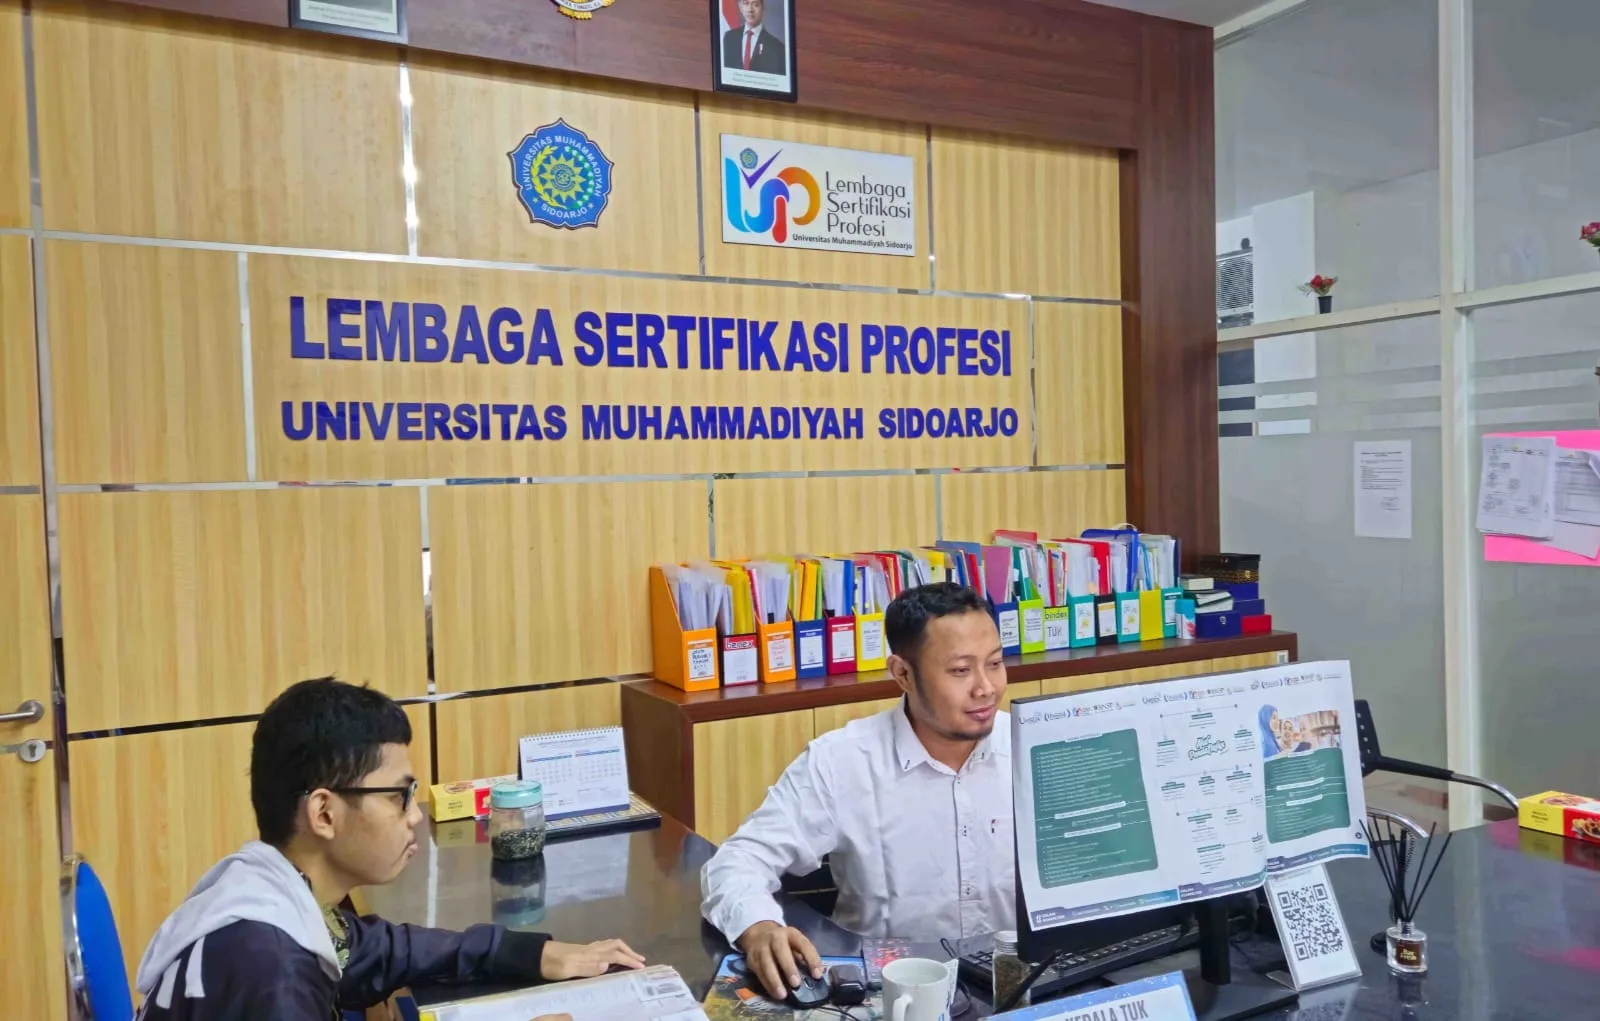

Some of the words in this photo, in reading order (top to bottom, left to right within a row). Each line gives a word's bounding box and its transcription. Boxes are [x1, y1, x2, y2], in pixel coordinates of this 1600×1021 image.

[522, 136, 553, 191] UNIVERSITAS
[554, 135, 603, 197] MUHAMMADIYAH
[825, 170, 906, 202] Lembaga
[541, 203, 588, 219] SIDOARJO
[826, 192, 912, 218] Sertifikasi
[827, 213, 886, 237] Profesi
[792, 233, 831, 244] Universitas
[831, 236, 885, 249] Muhammadiyah
[885, 240, 913, 251] Sidoarjo
[290, 296, 563, 366] LEMBAGA
[574, 311, 849, 373] SERTIFIKASI
[861, 324, 1012, 376] PROFESI
[282, 401, 567, 441] UNIVERSITAS
[582, 404, 864, 440] MUHAMMADIYAH
[878, 407, 1019, 439] SIDOARJO
[1120, 1000, 1149, 1021] TUK
